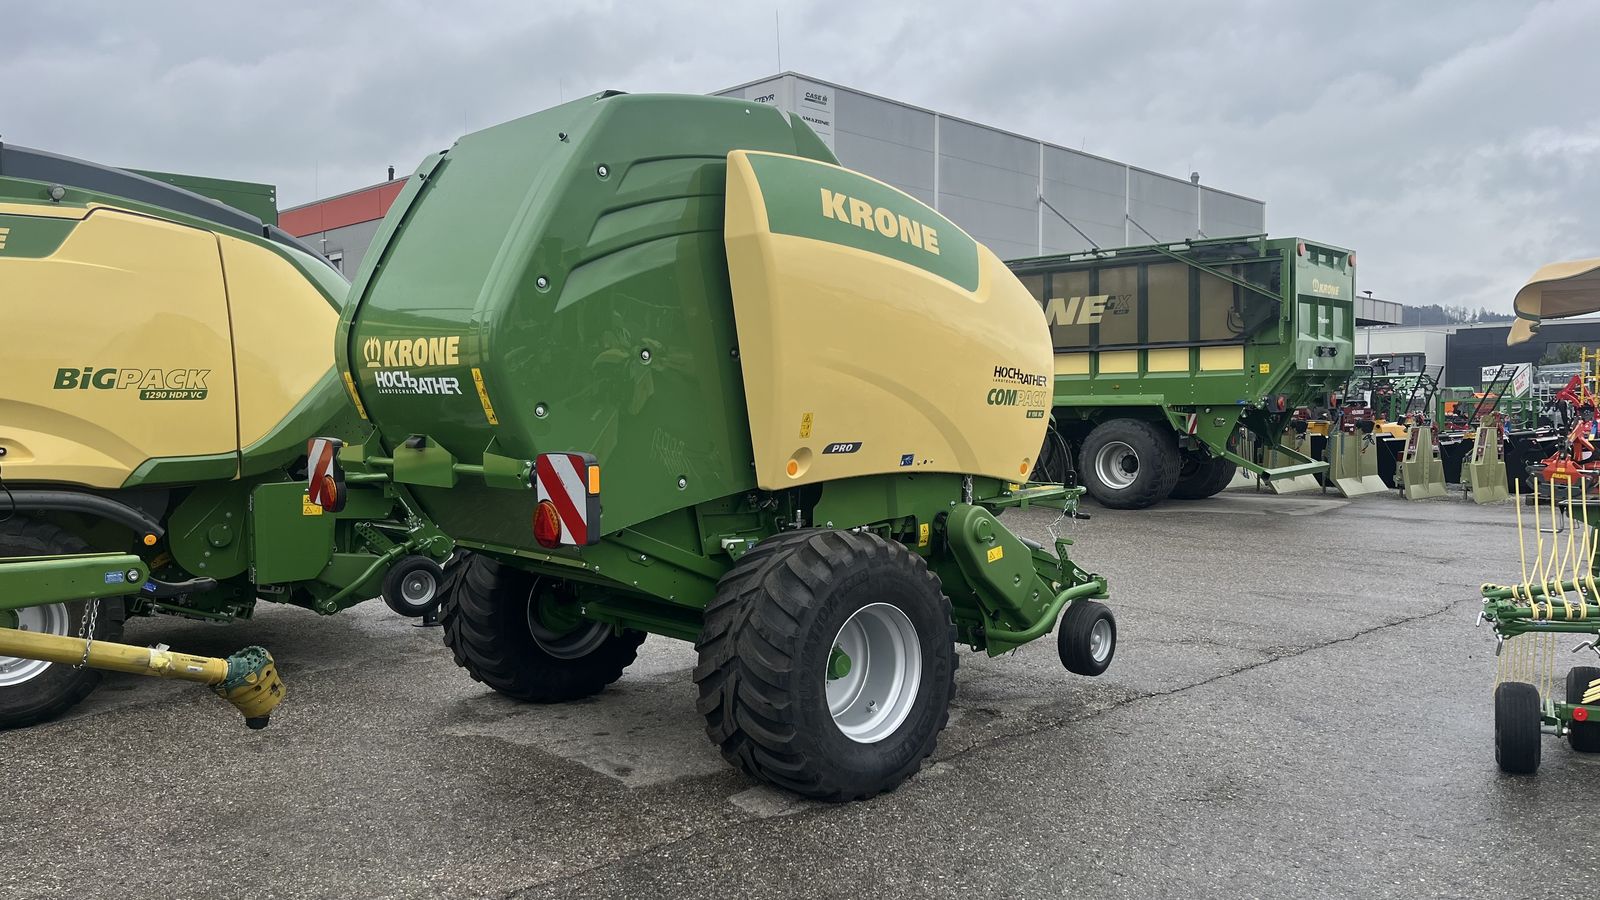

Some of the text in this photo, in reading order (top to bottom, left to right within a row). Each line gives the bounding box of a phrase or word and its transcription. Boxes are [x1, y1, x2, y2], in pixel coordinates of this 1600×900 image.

[805, 92, 821, 101] CASE
[821, 188, 940, 255] KRONE
[1036, 295, 1109, 326] NE
[384, 336, 460, 367] KRONE
[145, 391, 203, 399] 1290 HDP VC
[831, 444, 853, 453] PRO
